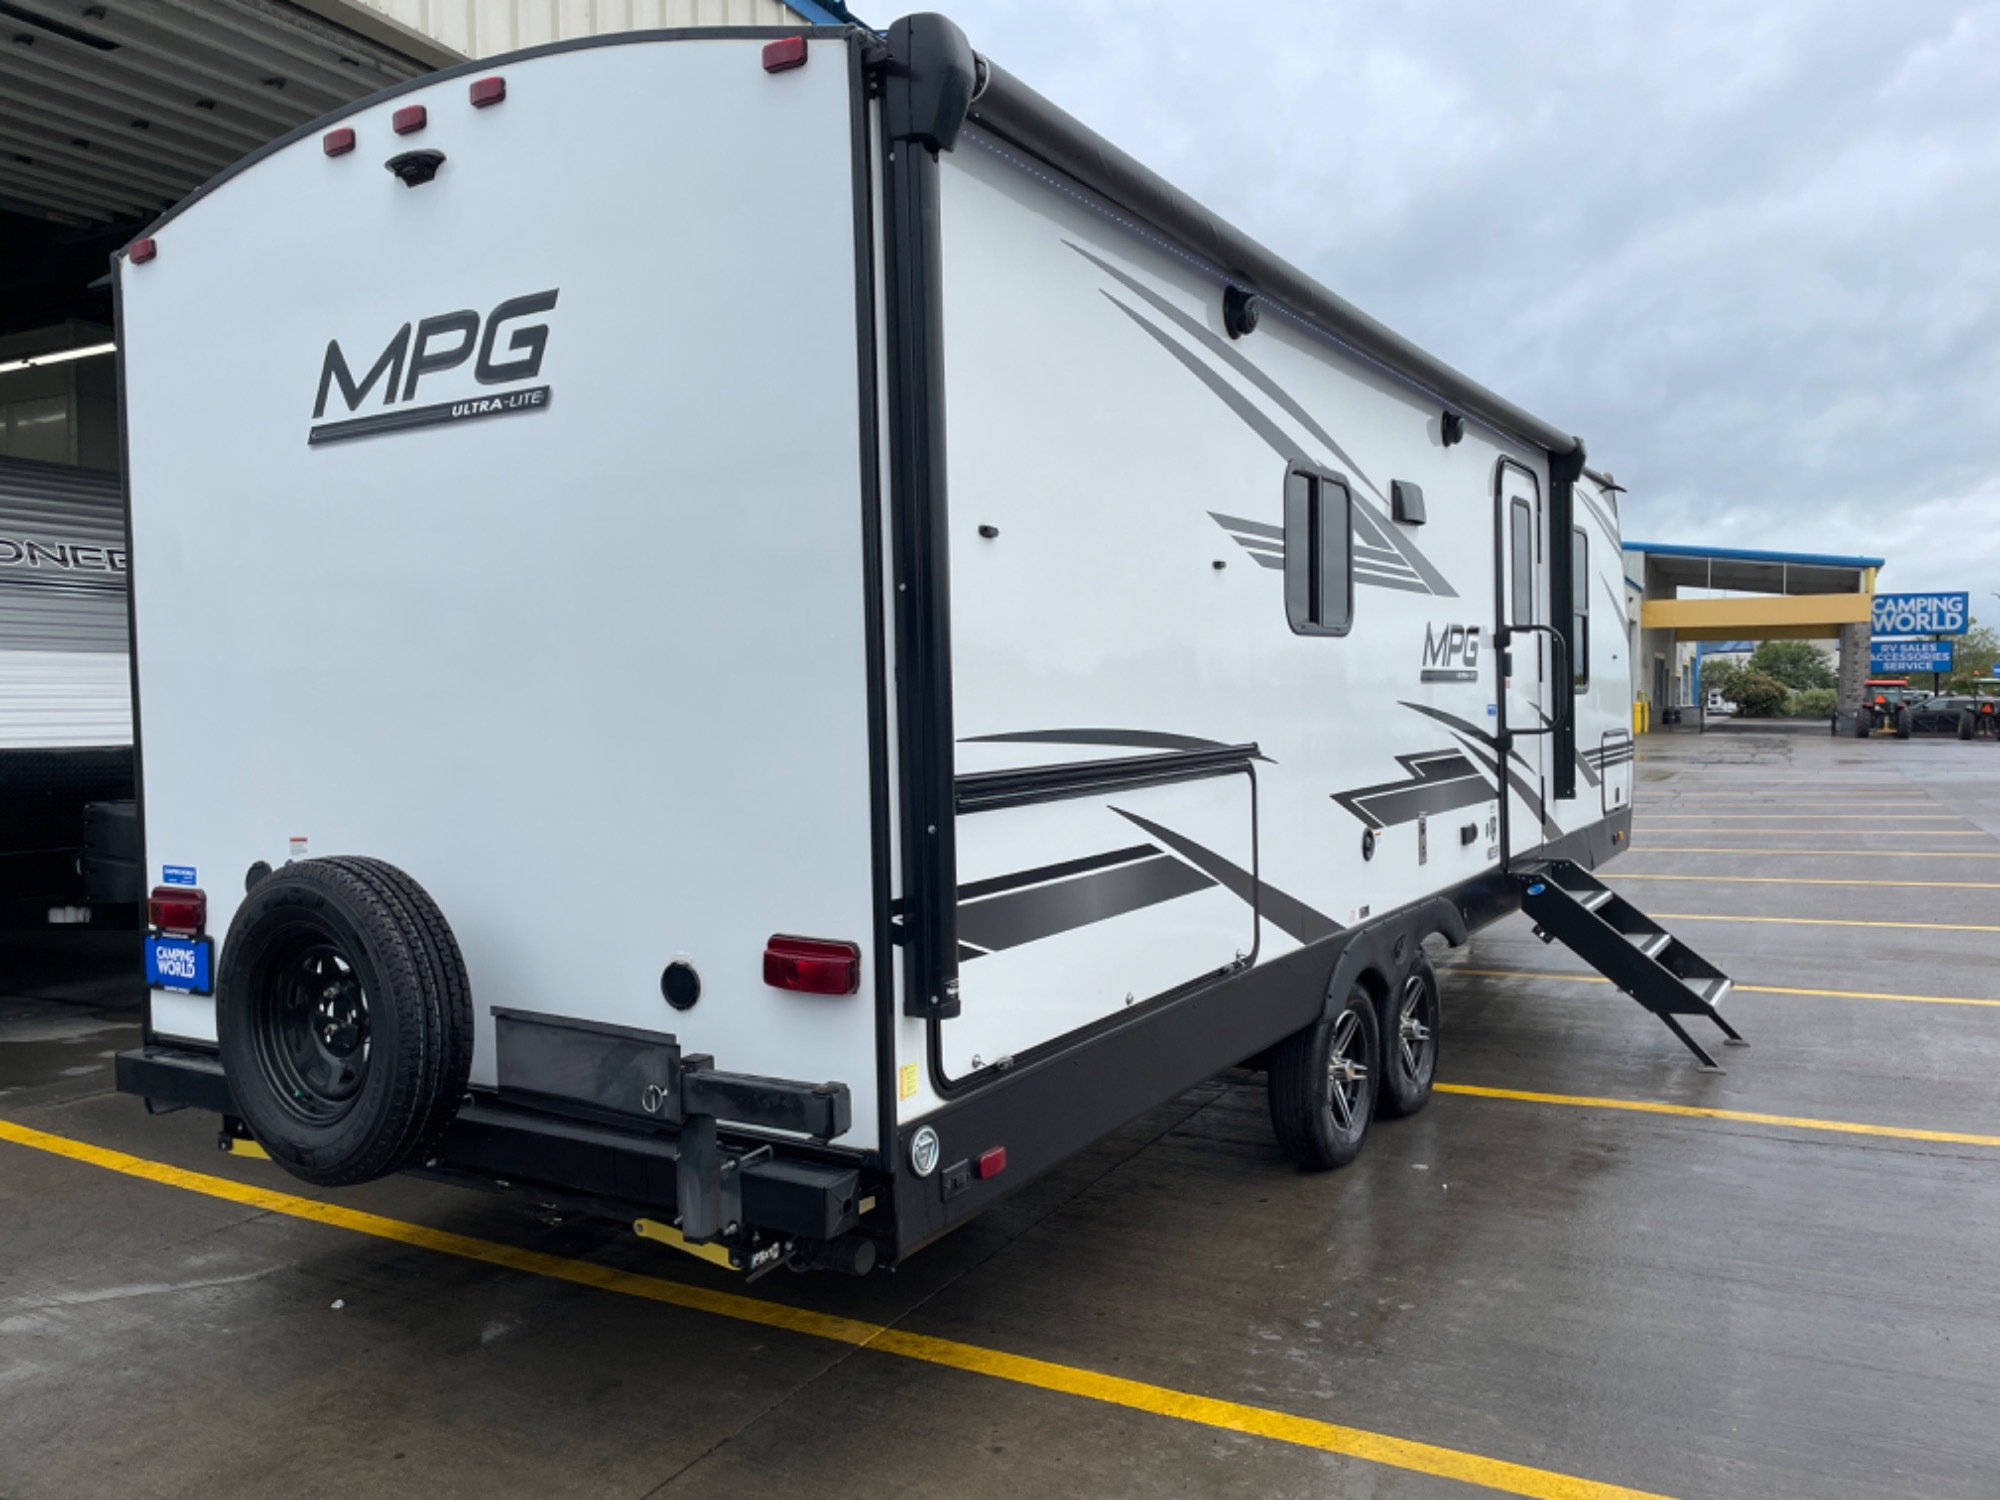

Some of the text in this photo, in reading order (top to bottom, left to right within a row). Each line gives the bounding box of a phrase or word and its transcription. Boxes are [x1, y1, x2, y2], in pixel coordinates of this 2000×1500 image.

[311, 288, 560, 419] MPG
[451, 390, 544, 417] ULTRA-LITE
[1872, 597, 1963, 614] CAMPING
[1872, 612, 1963, 632] WORLD
[1422, 620, 1480, 667] MPG
[1881, 642, 1937, 652] RV SALES
[1883, 661, 1933, 671] SERVICE
[156, 946, 195, 963] CAMPING
[157, 959, 195, 978] WORLD
